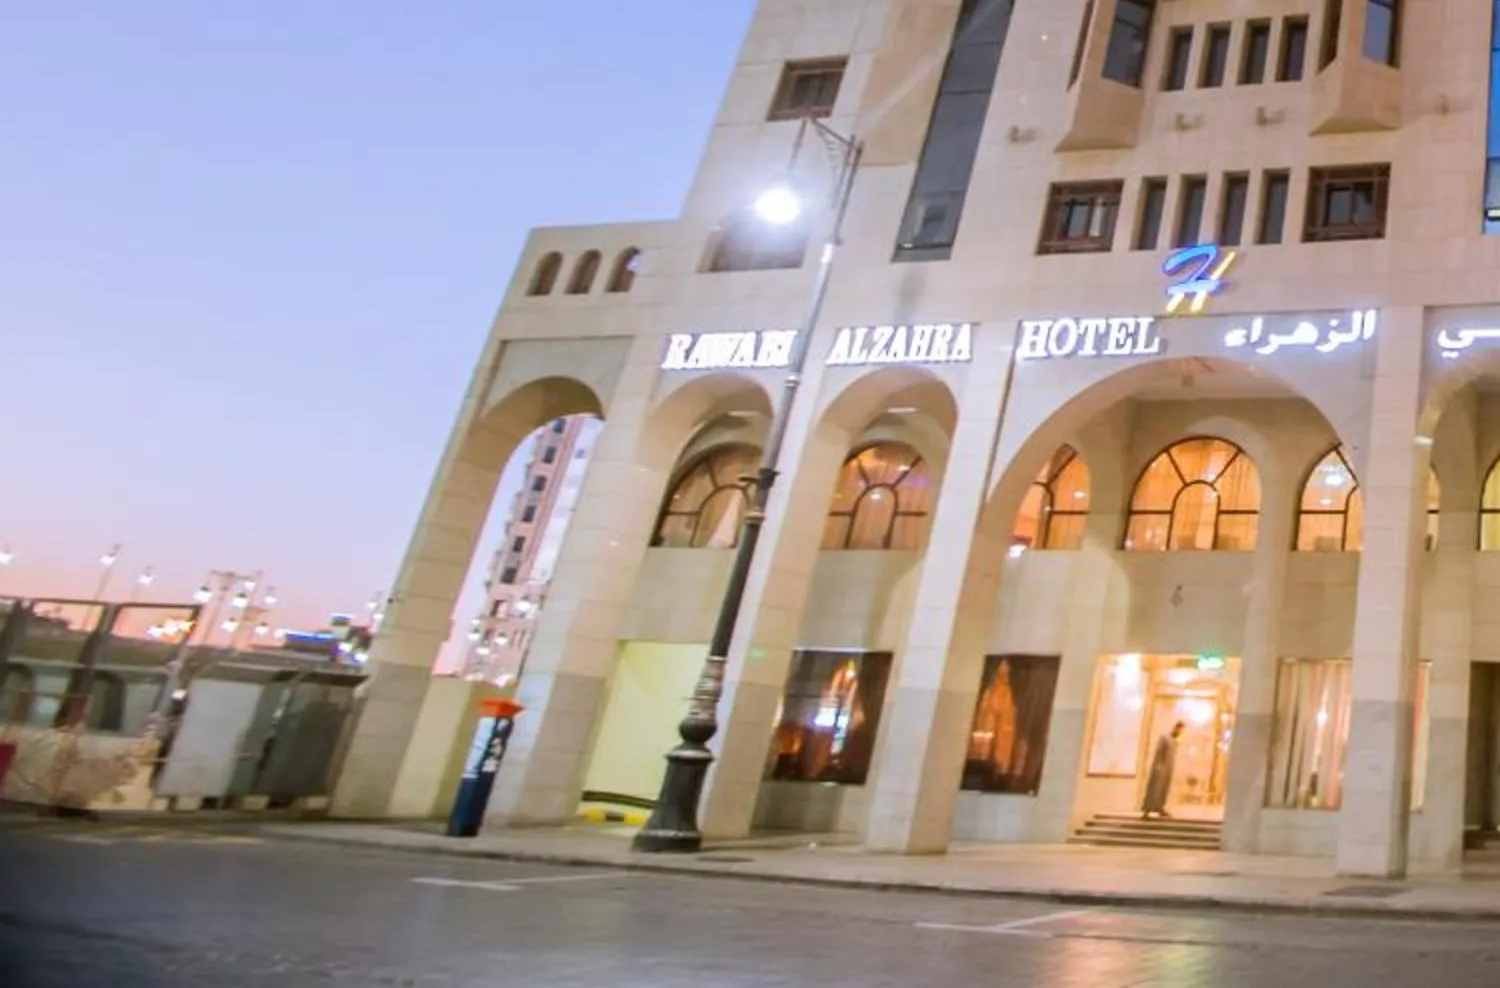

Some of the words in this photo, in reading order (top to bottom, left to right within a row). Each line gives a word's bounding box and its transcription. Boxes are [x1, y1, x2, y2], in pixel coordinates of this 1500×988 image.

[660, 330, 798, 369] RAWABI
[824, 323, 972, 365] ALZAHRA
[1016, 317, 1160, 358] HOTEL
[1224, 309, 1376, 355] الزهراء
